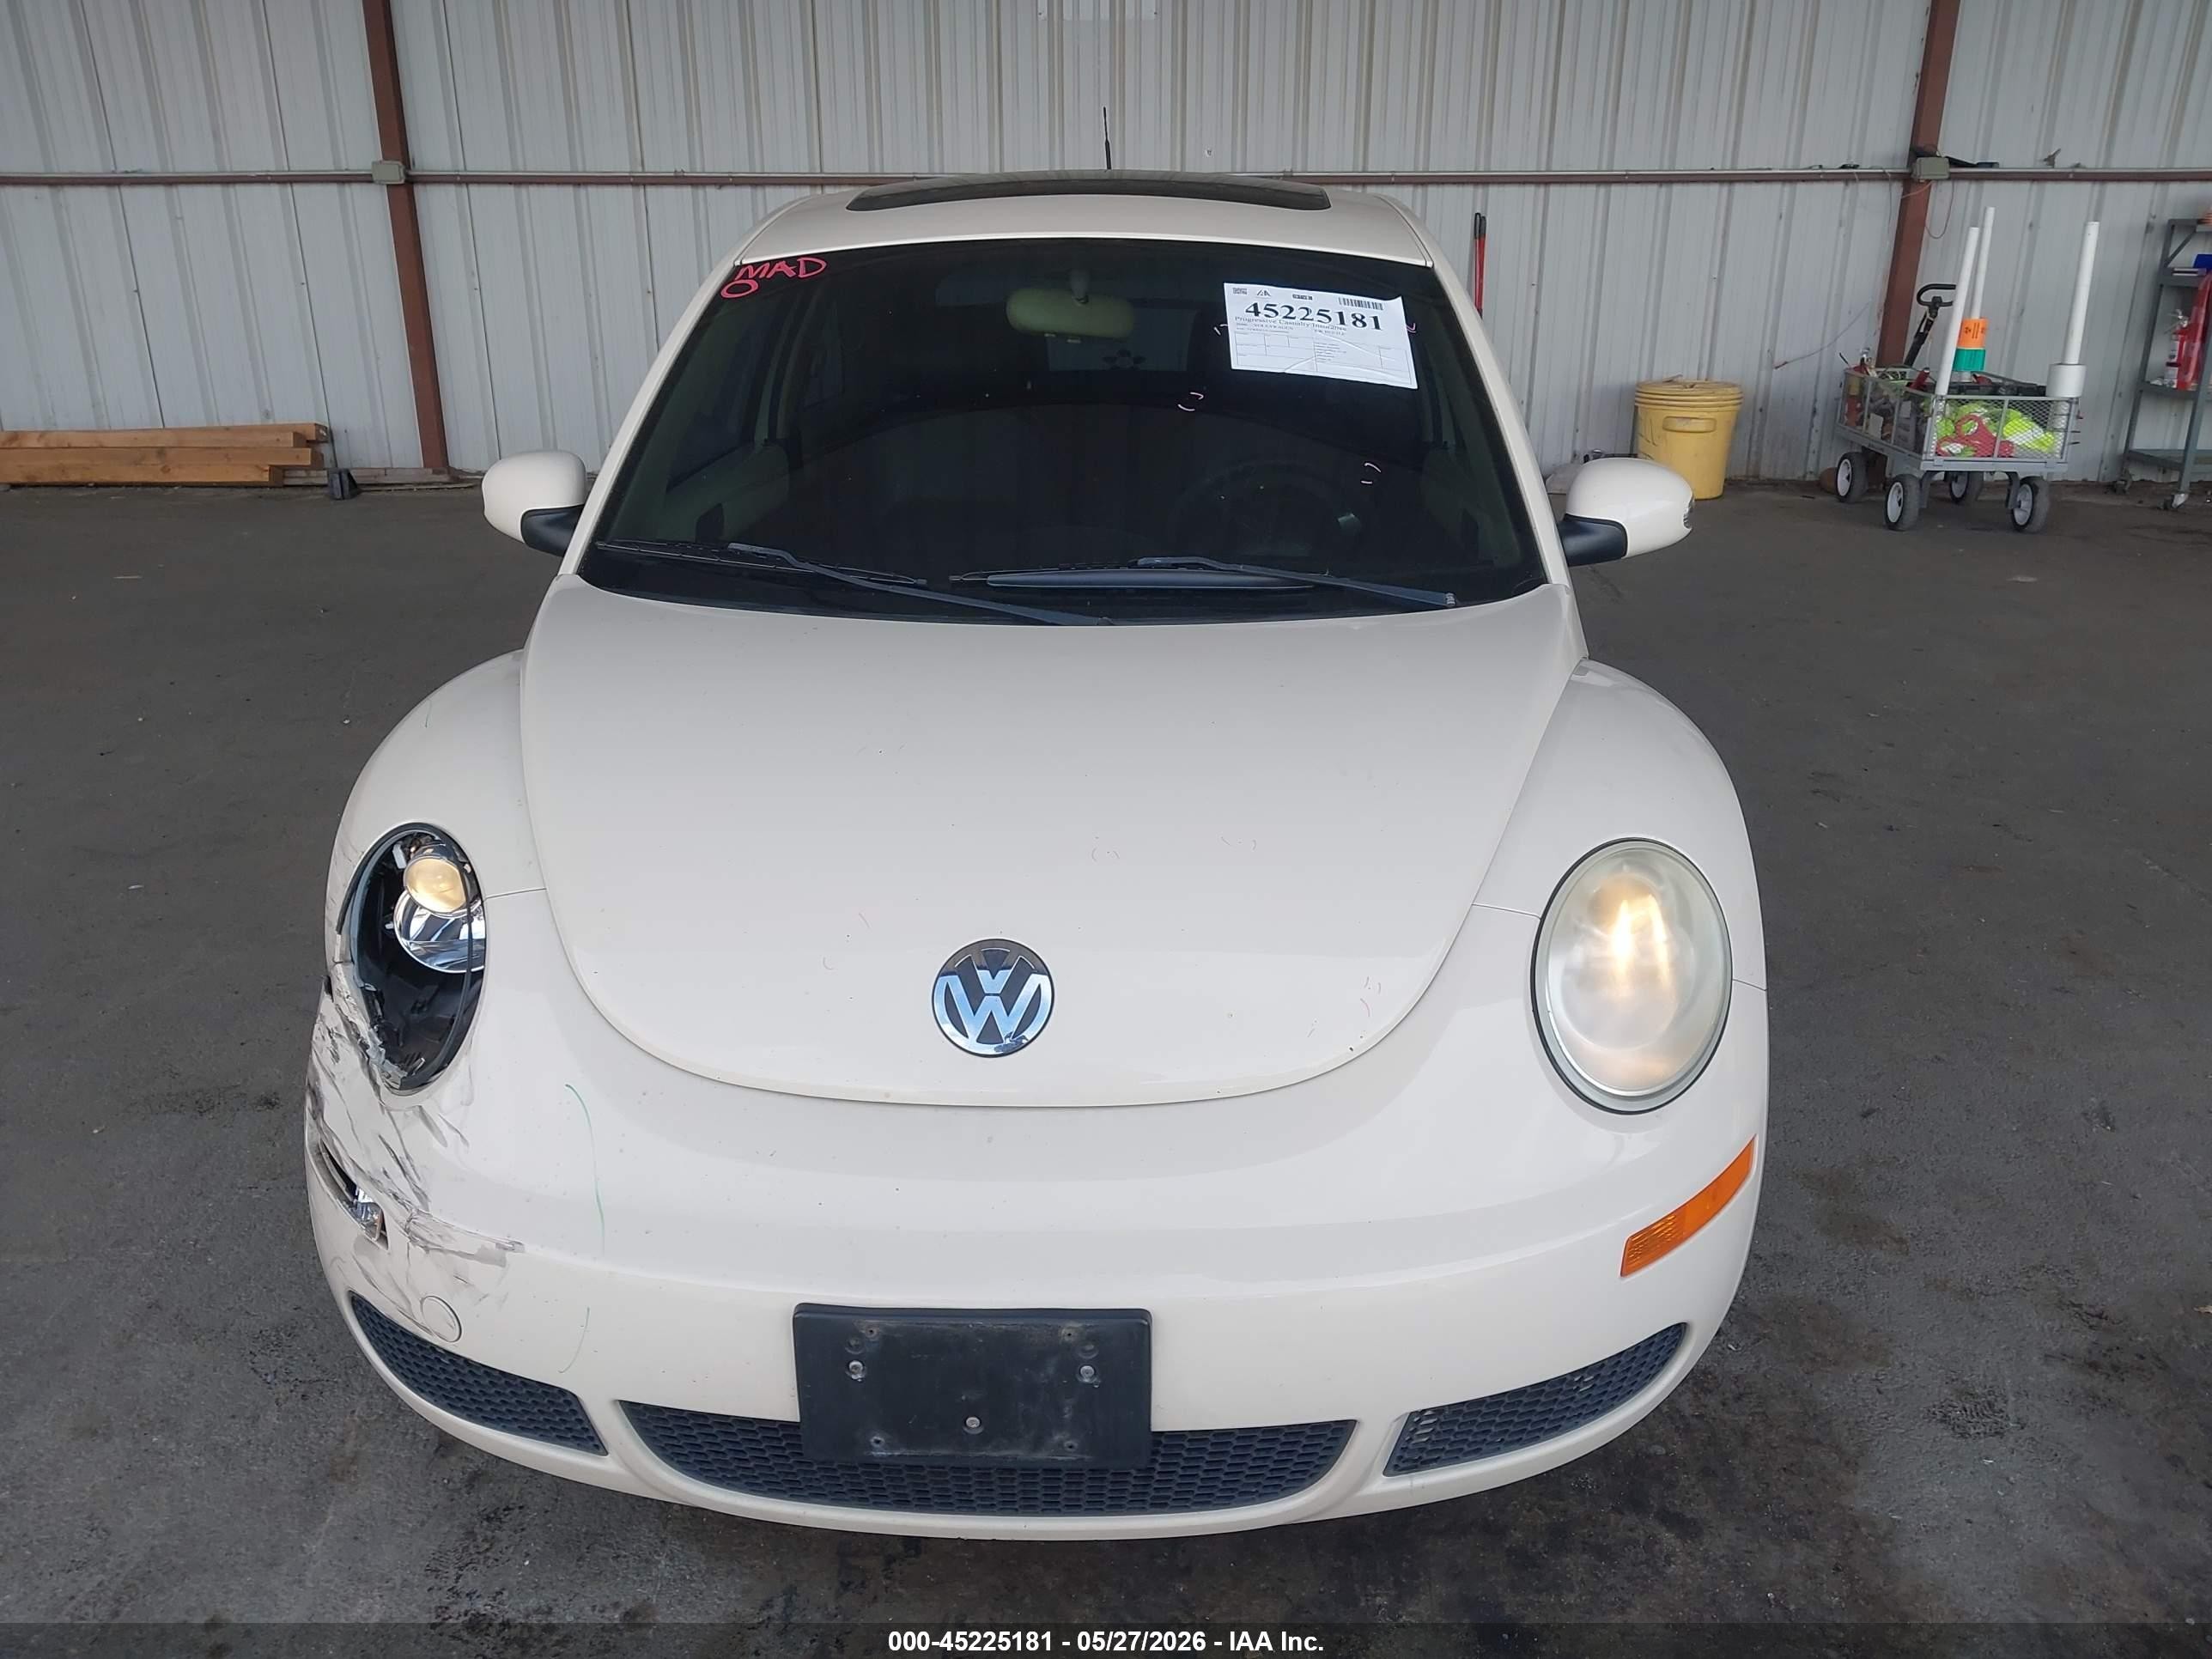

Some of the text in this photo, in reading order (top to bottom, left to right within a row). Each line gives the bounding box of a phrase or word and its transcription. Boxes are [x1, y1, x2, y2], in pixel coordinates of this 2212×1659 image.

[734, 257, 828, 281] MAD
[1245, 301, 1382, 331] 45225181
[933, 939, 1054, 1057] VW
